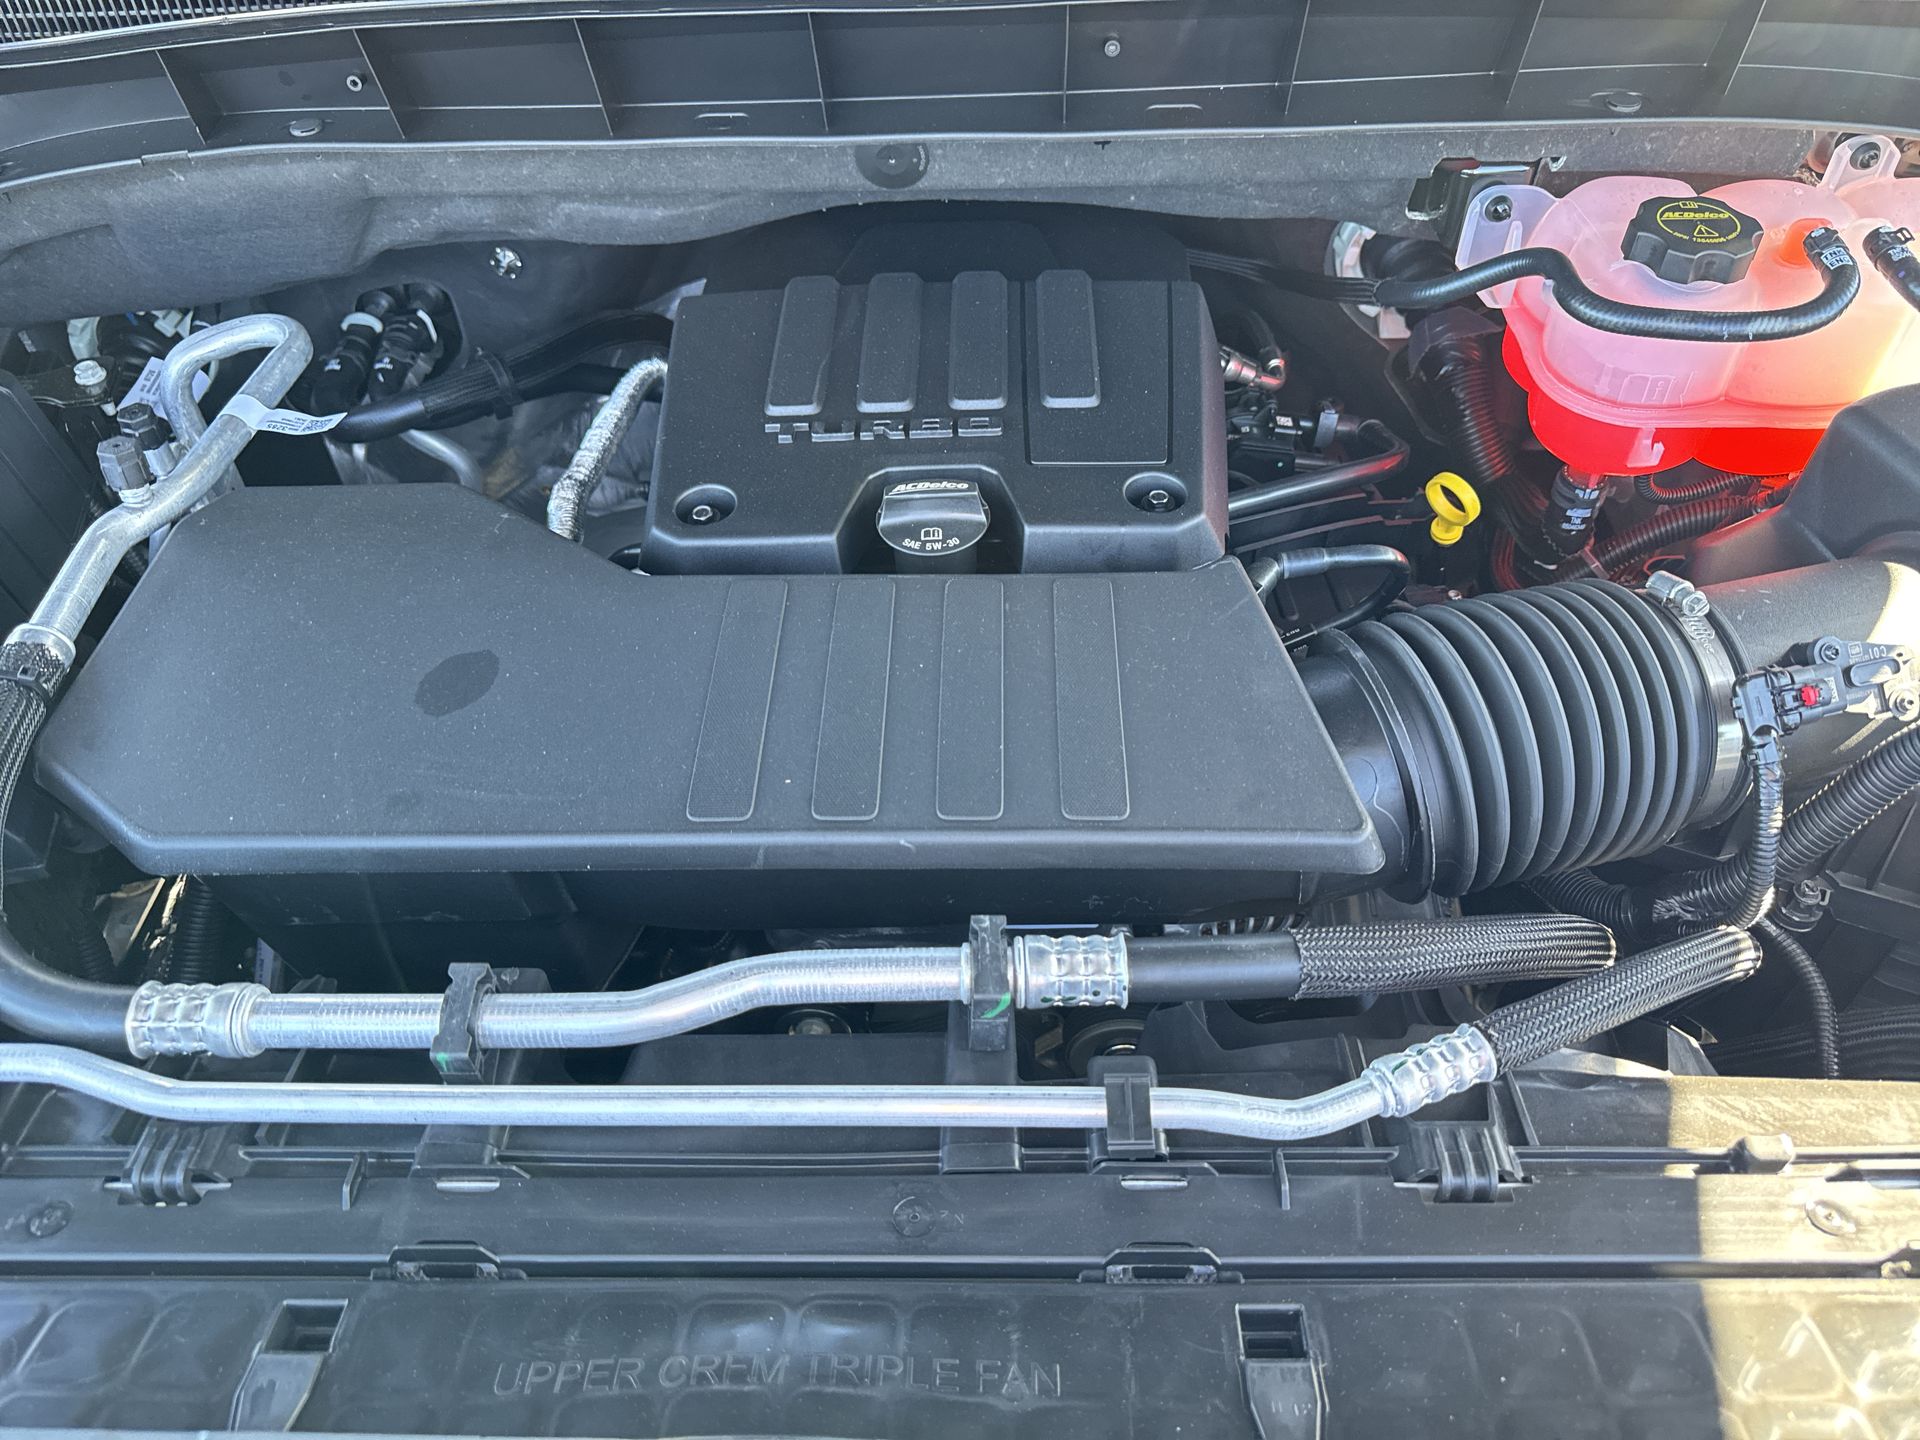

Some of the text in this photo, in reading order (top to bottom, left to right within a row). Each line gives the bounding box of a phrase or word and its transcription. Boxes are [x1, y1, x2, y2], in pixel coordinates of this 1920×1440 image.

[1661, 211, 1730, 219] ACDelco
[765, 416, 1003, 444] TURBO
[890, 481, 969, 492] ACDelco
[902, 537, 960, 550] SAE 5W-30
[493, 1357, 645, 1396] UPPER
[803, 1353, 960, 1392] TRIPLE
[976, 1359, 1061, 1397] FAN
